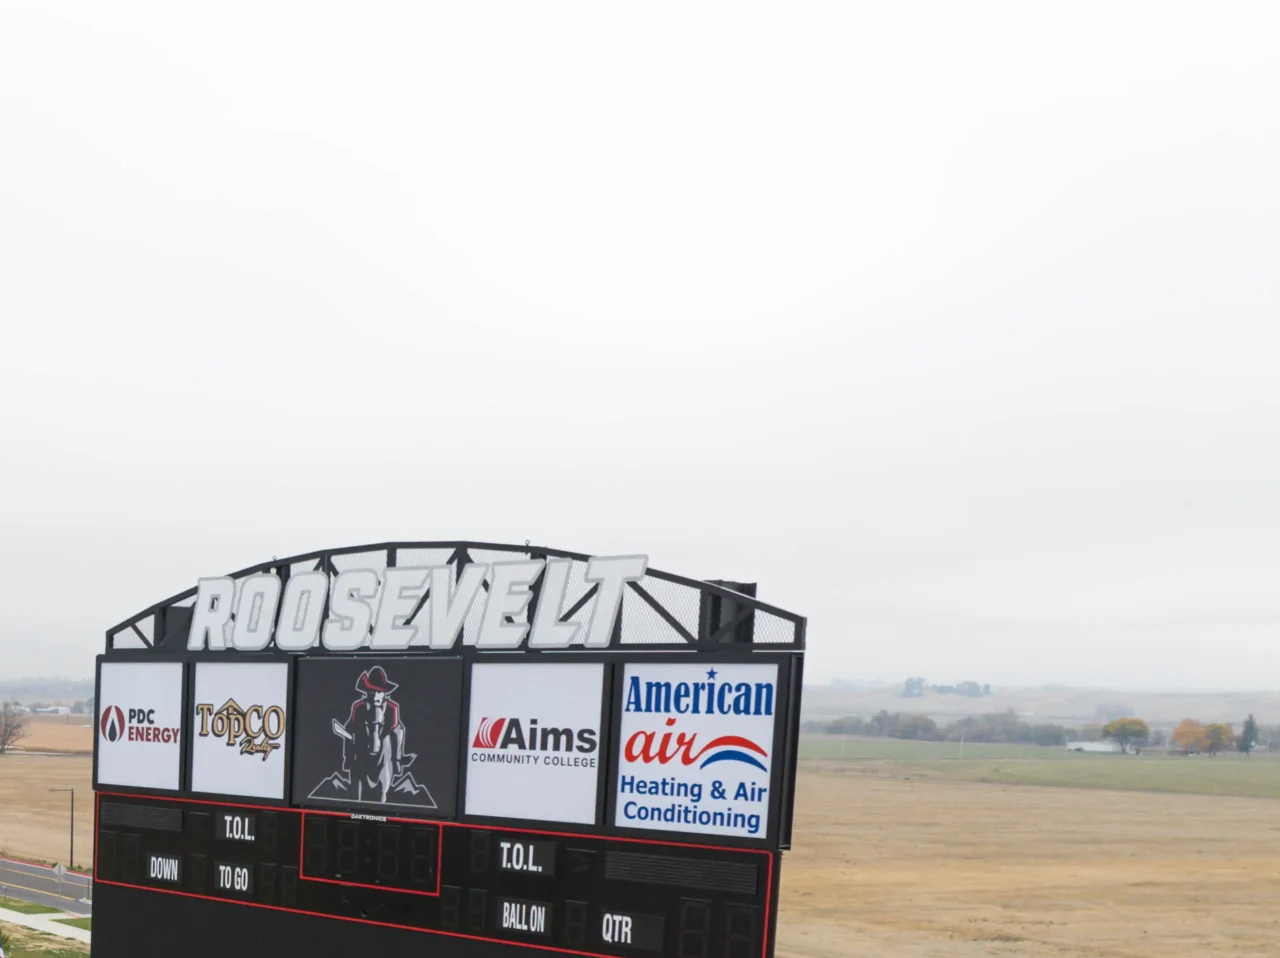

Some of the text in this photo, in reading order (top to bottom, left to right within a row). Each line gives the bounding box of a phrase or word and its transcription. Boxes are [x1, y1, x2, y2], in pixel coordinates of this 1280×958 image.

[186, 554, 649, 650] ROOSEVELT
[624, 674, 774, 716] American
[128, 708, 155, 725] PDC
[128, 726, 180, 743] ENERGY
[499, 717, 597, 753] Aims
[623, 717, 700, 766] air
[471, 752, 596, 768] COMMUNITY COLLEGE
[620, 775, 767, 803] Heating & Air
[224, 815, 255, 841] T.O.L.
[350, 813, 387, 822] DAKTRONICS
[623, 801, 761, 832] Conditioning
[150, 856, 178, 881] DOWN
[500, 842, 542, 872] T.O.L.
[219, 865, 249, 891] TO GO
[502, 902, 545, 932] BALL ON
[602, 913, 632, 944] QTR
